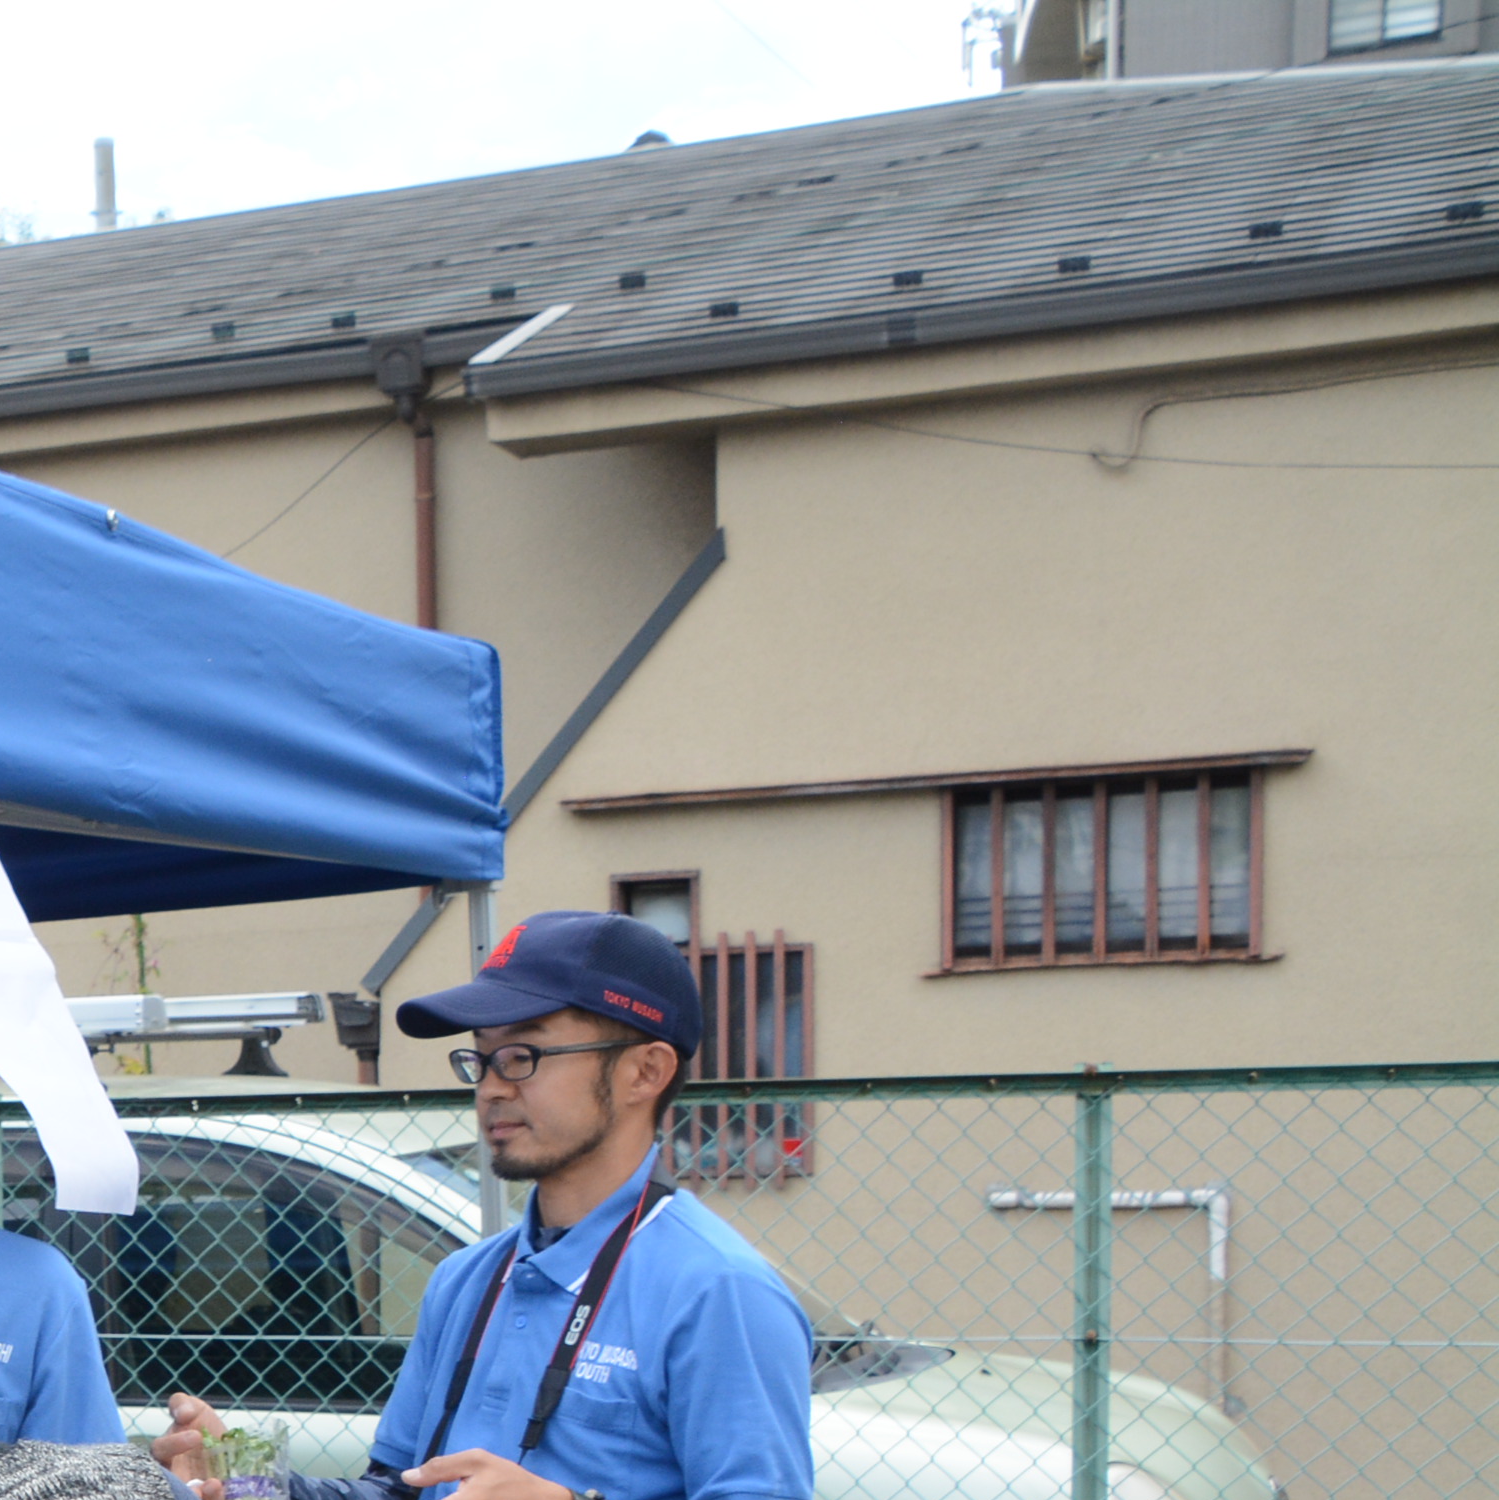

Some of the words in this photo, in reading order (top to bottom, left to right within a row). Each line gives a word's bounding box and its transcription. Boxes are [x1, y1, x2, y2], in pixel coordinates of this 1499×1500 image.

[604, 990, 631, 1008] TOKYO
[564, 1305, 591, 1346] EOS
[575, 1361, 611, 1384] OUTH
